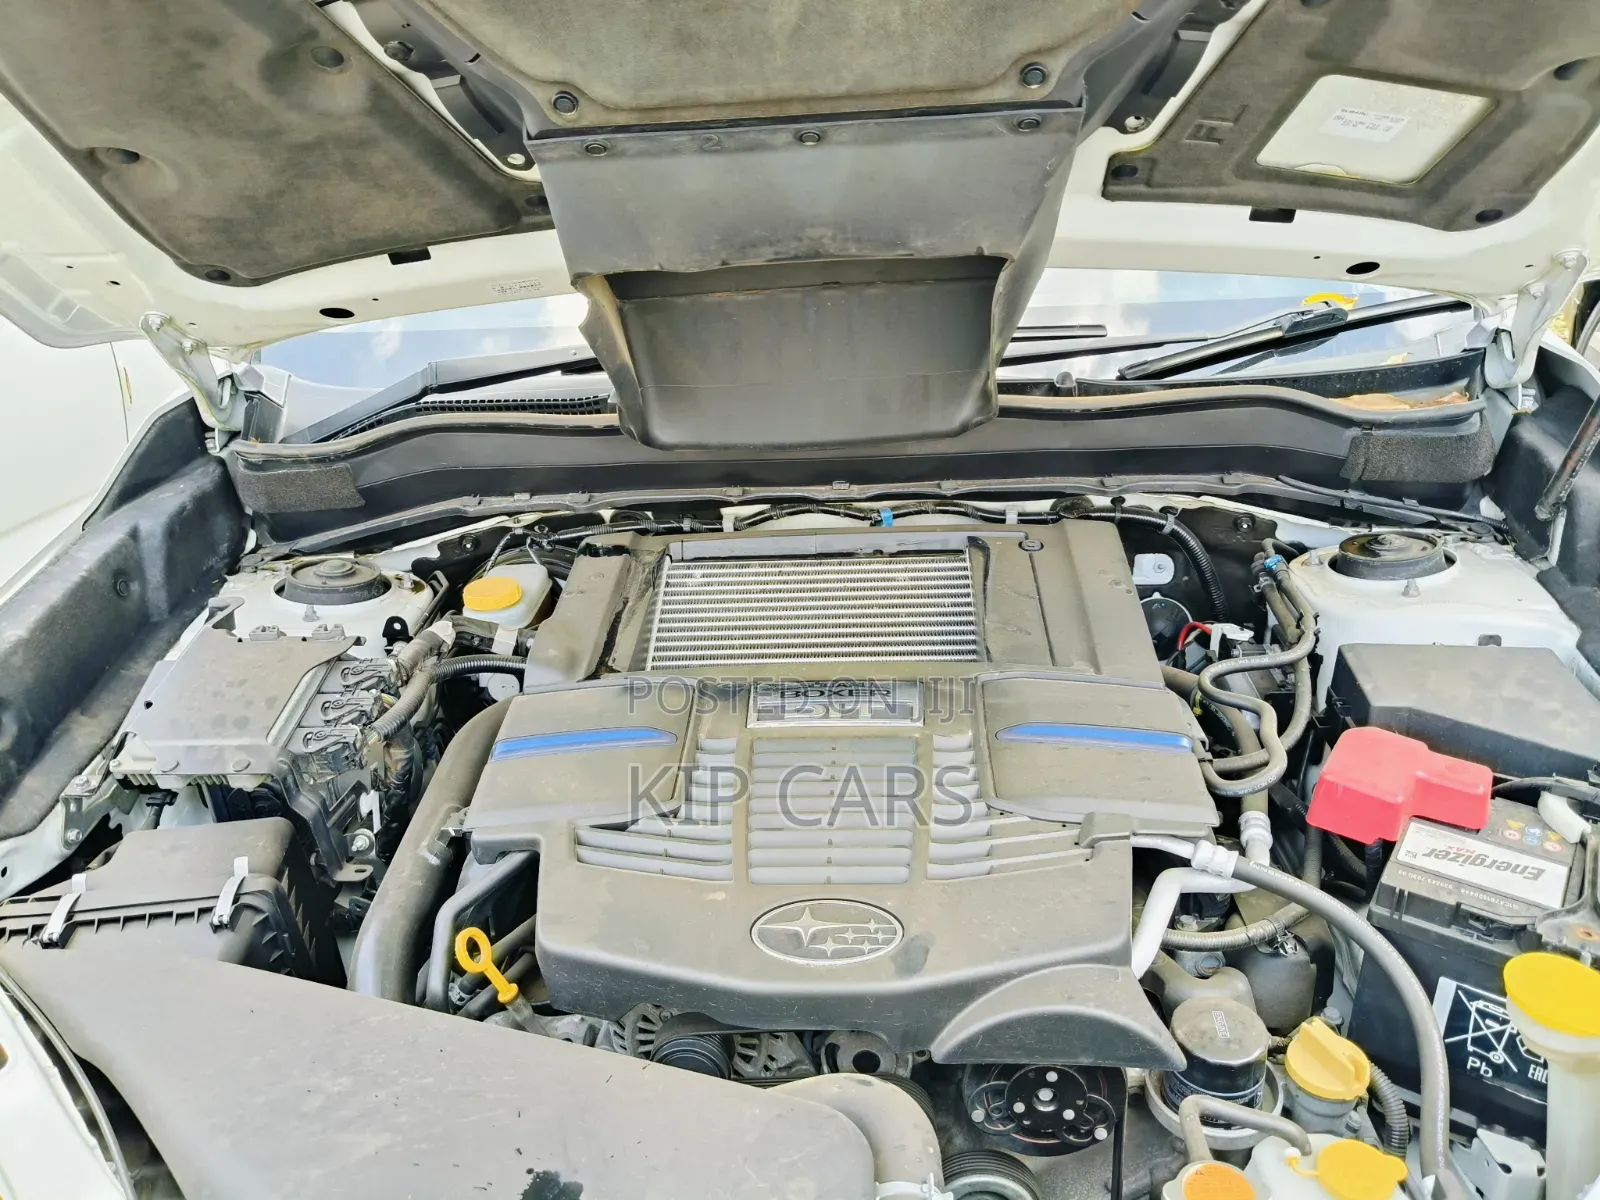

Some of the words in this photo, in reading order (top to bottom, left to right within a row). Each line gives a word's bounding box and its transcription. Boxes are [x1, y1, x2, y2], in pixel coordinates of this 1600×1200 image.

[1184, 103, 1250, 146] FL
[700, 133, 721, 151] 2
[780, 689, 892, 699] BOXER
[1447, 845, 1476, 854] MAX
[1423, 848, 1546, 881] Energizer
[1467, 1056, 1493, 1078] Pb
